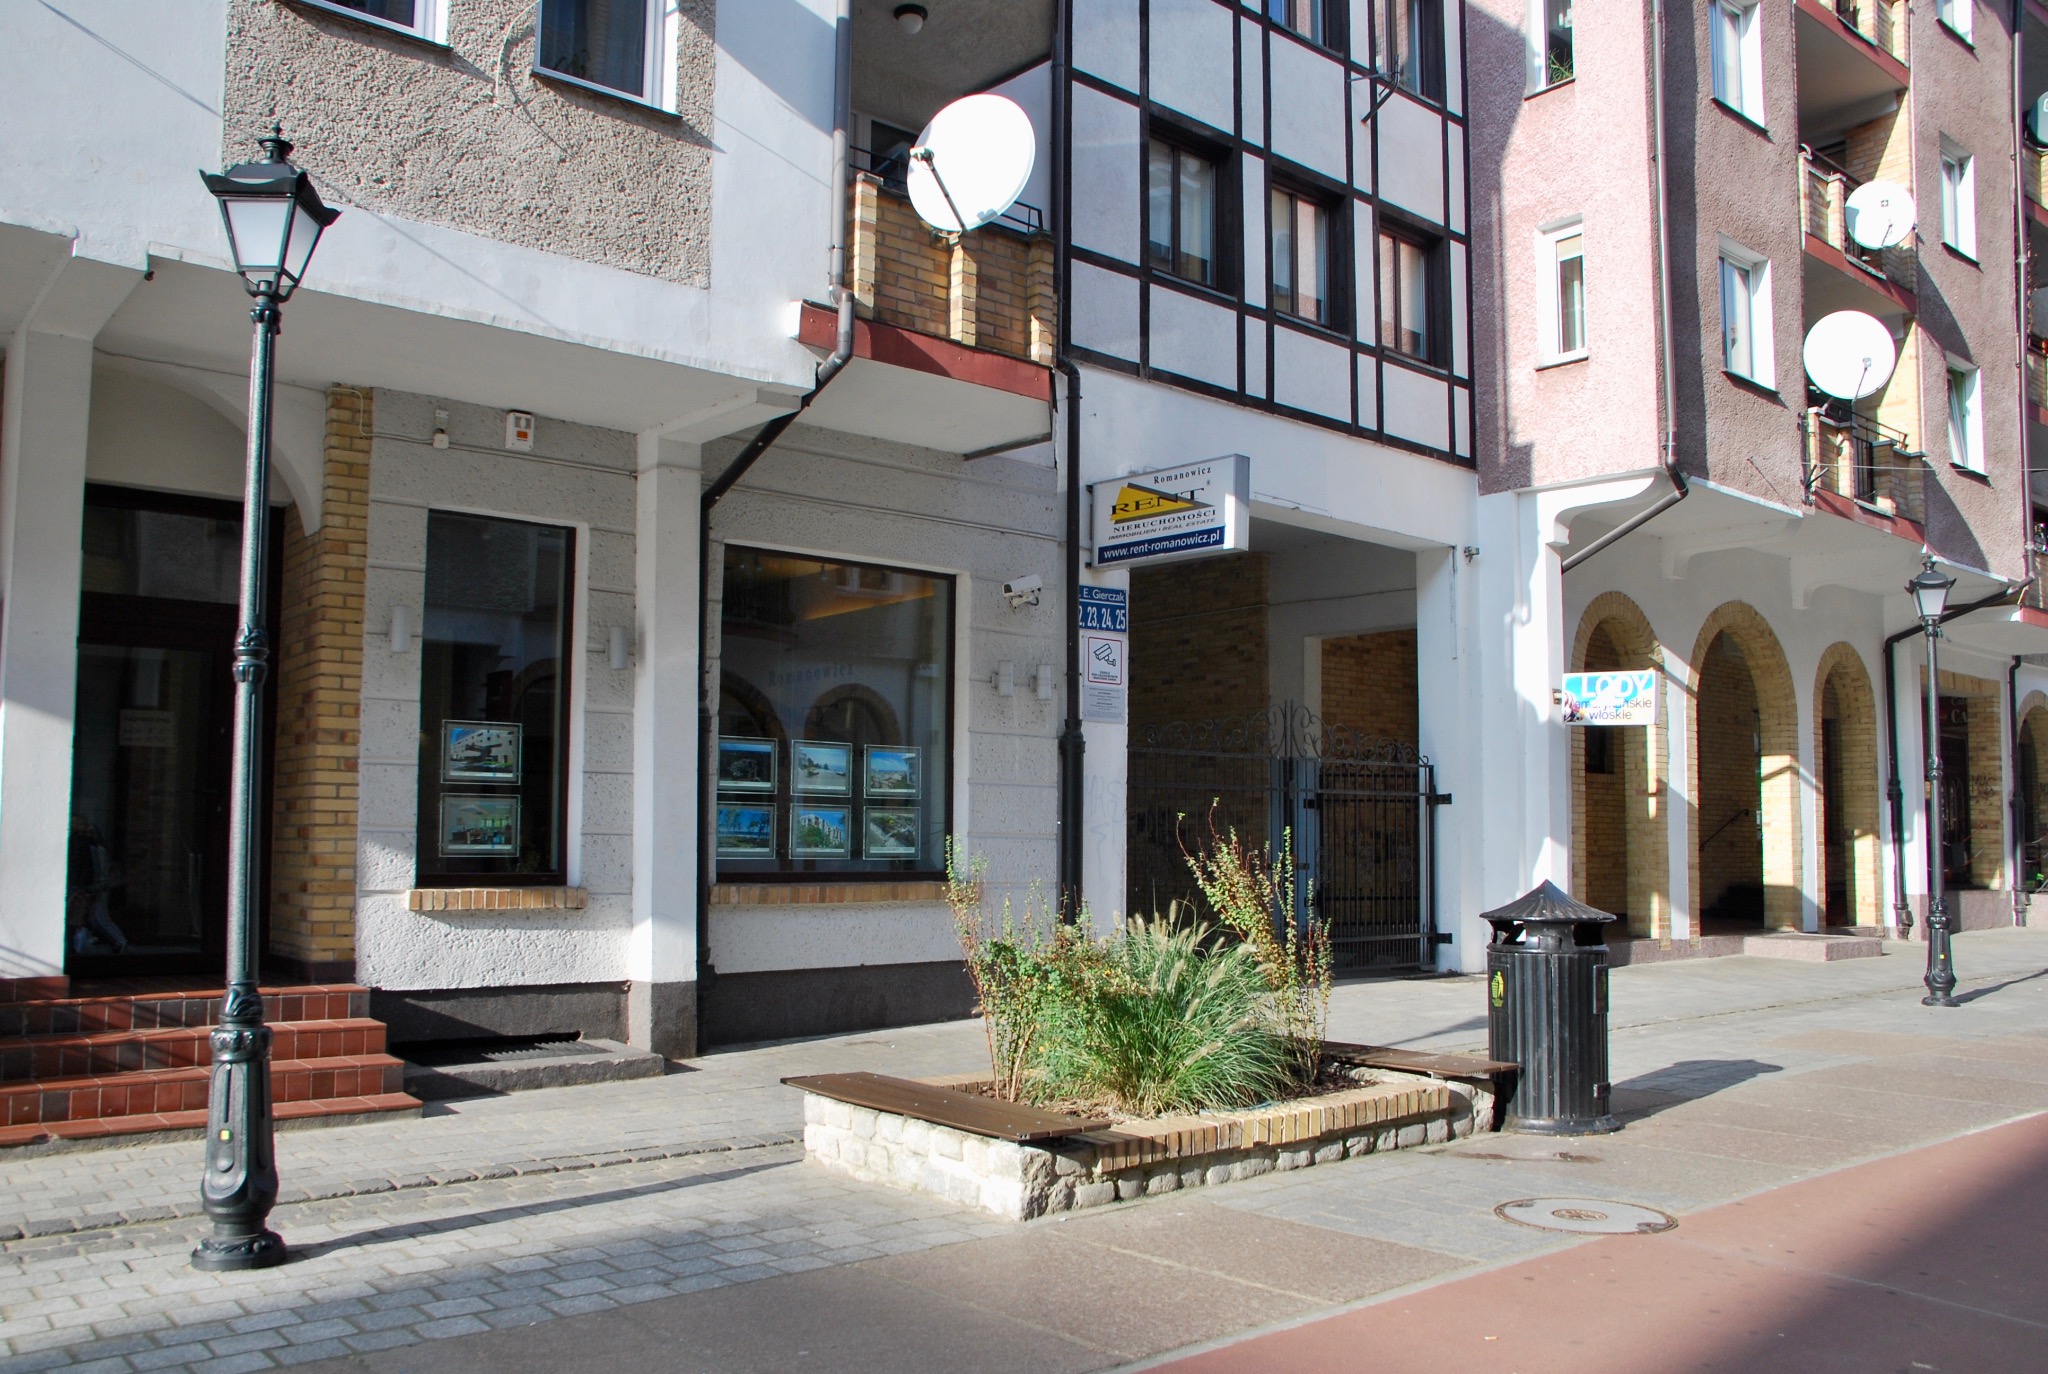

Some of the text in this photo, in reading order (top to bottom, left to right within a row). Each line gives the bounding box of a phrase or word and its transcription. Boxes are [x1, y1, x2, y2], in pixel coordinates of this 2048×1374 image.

[1153, 467, 1212, 485] Romanowicz
[1109, 487, 1205, 515] RENT
[1113, 509, 1216, 533] NIERUCHOMOŚCI
[1104, 529, 1220, 559] www.rent-romanowicz.pl
[1108, 528, 1157, 541] IMMOBILIEN
[1083, 588, 1091, 598] E.
[1087, 606, 1100, 630] 23,
[1101, 607, 1114, 630] 24,
[1115, 609, 1126, 630] 25
[1581, 675, 1650, 698] LODY
